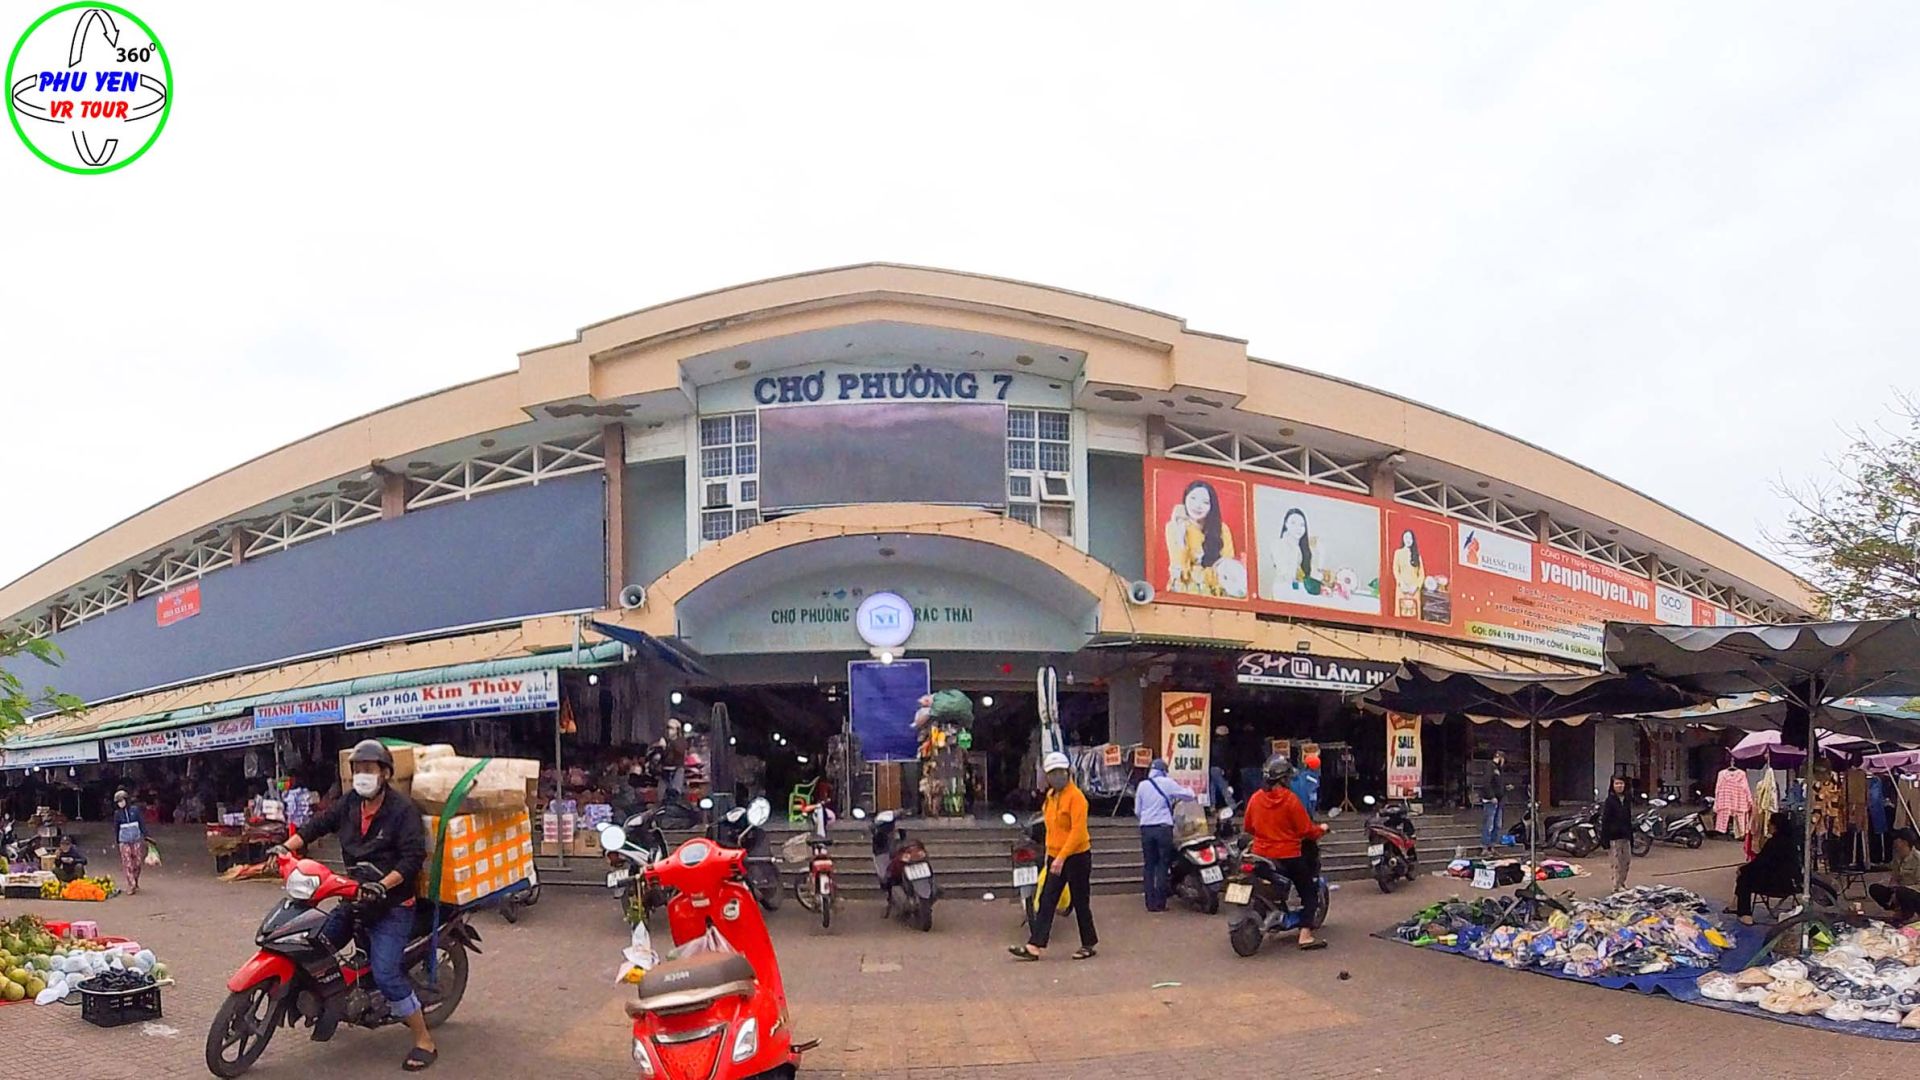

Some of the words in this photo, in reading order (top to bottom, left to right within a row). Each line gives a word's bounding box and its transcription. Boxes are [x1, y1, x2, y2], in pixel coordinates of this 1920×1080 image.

[754, 370, 825, 404] CHỢ
[838, 363, 979, 400] PHƯỜNG
[993, 374, 1013, 400] 7
[1540, 560, 1649, 610] yenphuyen.vn
[1316, 663, 1360, 683] LÂM
[422, 687, 462, 701] Kim
[257, 705, 295, 719] THANH
[299, 700, 339, 714] THANH
[1177, 732, 1200, 749] SALE
